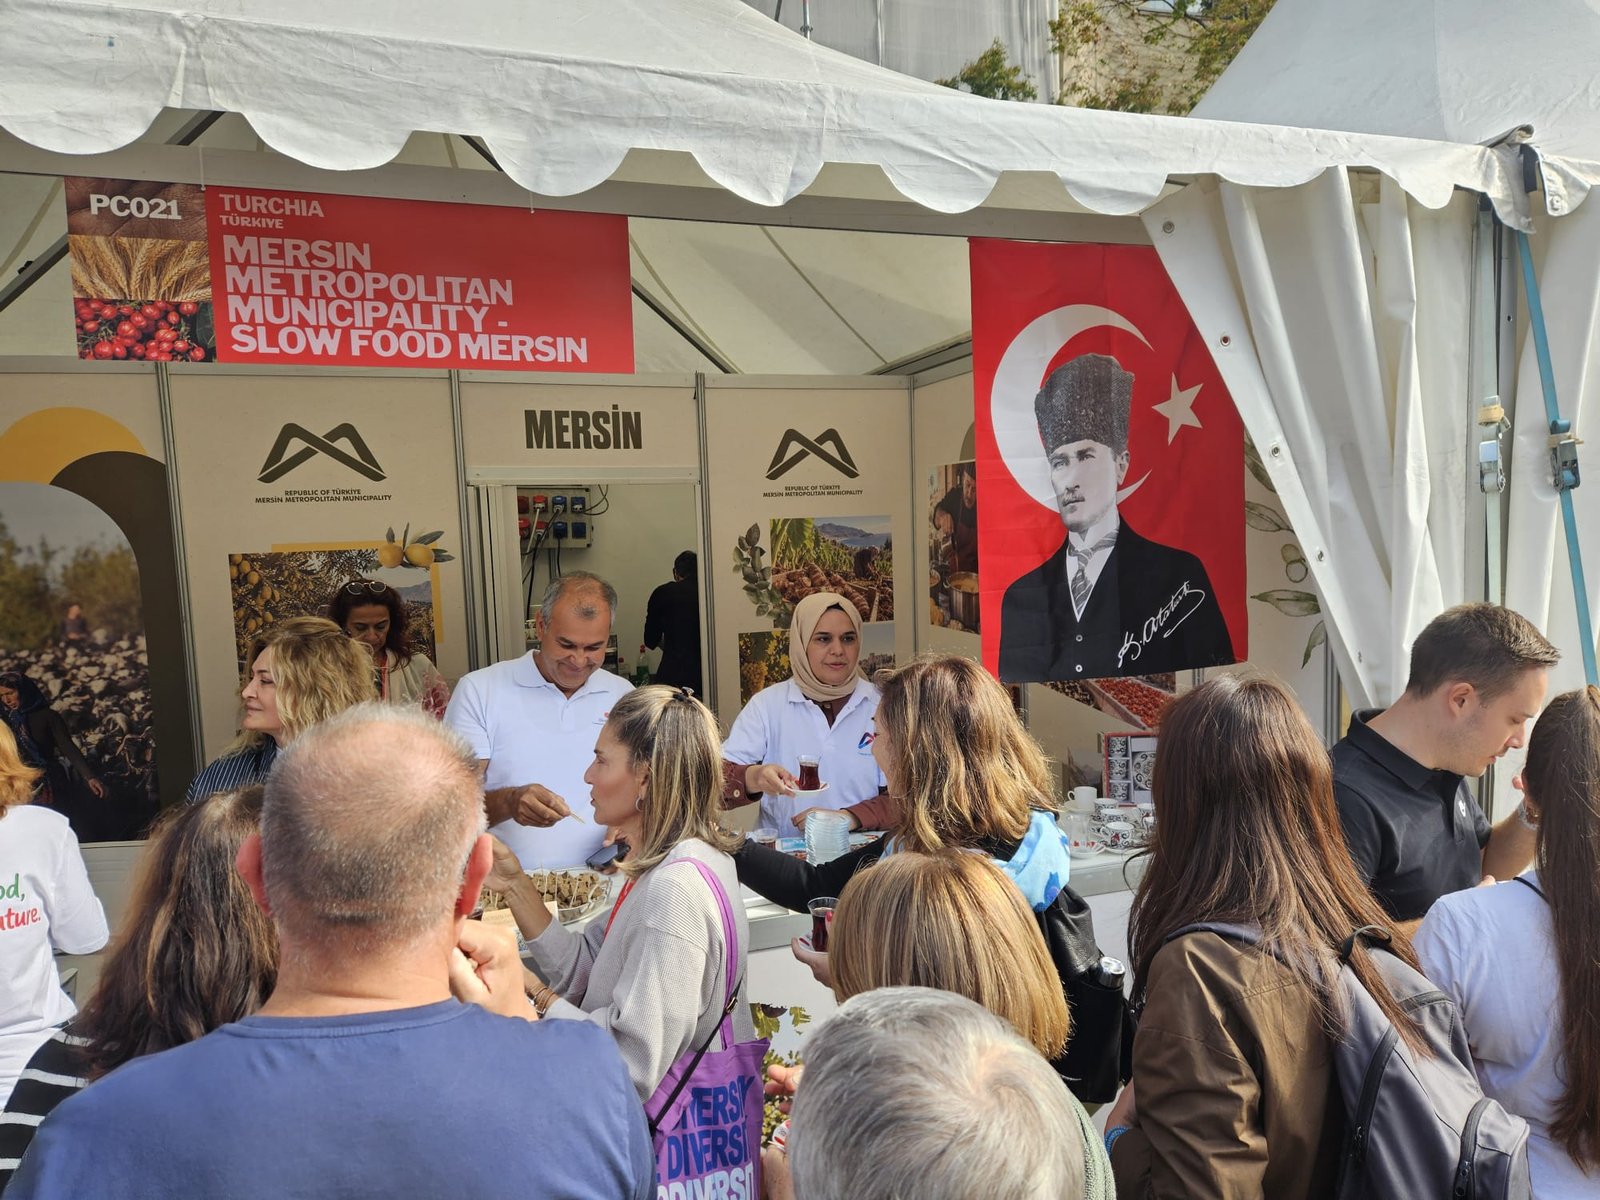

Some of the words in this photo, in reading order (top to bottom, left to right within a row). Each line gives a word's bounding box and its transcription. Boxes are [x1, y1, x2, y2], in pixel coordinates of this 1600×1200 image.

[89, 193, 182, 220] PC021
[219, 193, 324, 217] TURCHIA
[223, 234, 371, 270] MERSIN
[225, 264, 513, 306] METROPOLITAN
[227, 294, 490, 333] MUNICIPALITY
[231, 323, 342, 356] SLOW
[350, 328, 452, 359] FOOD
[458, 332, 588, 363] MERSIN
[524, 403, 643, 450] MERSİN
[285, 495, 340, 503] METROPOLITAN
[342, 494, 392, 502] MUNICIPALITY
